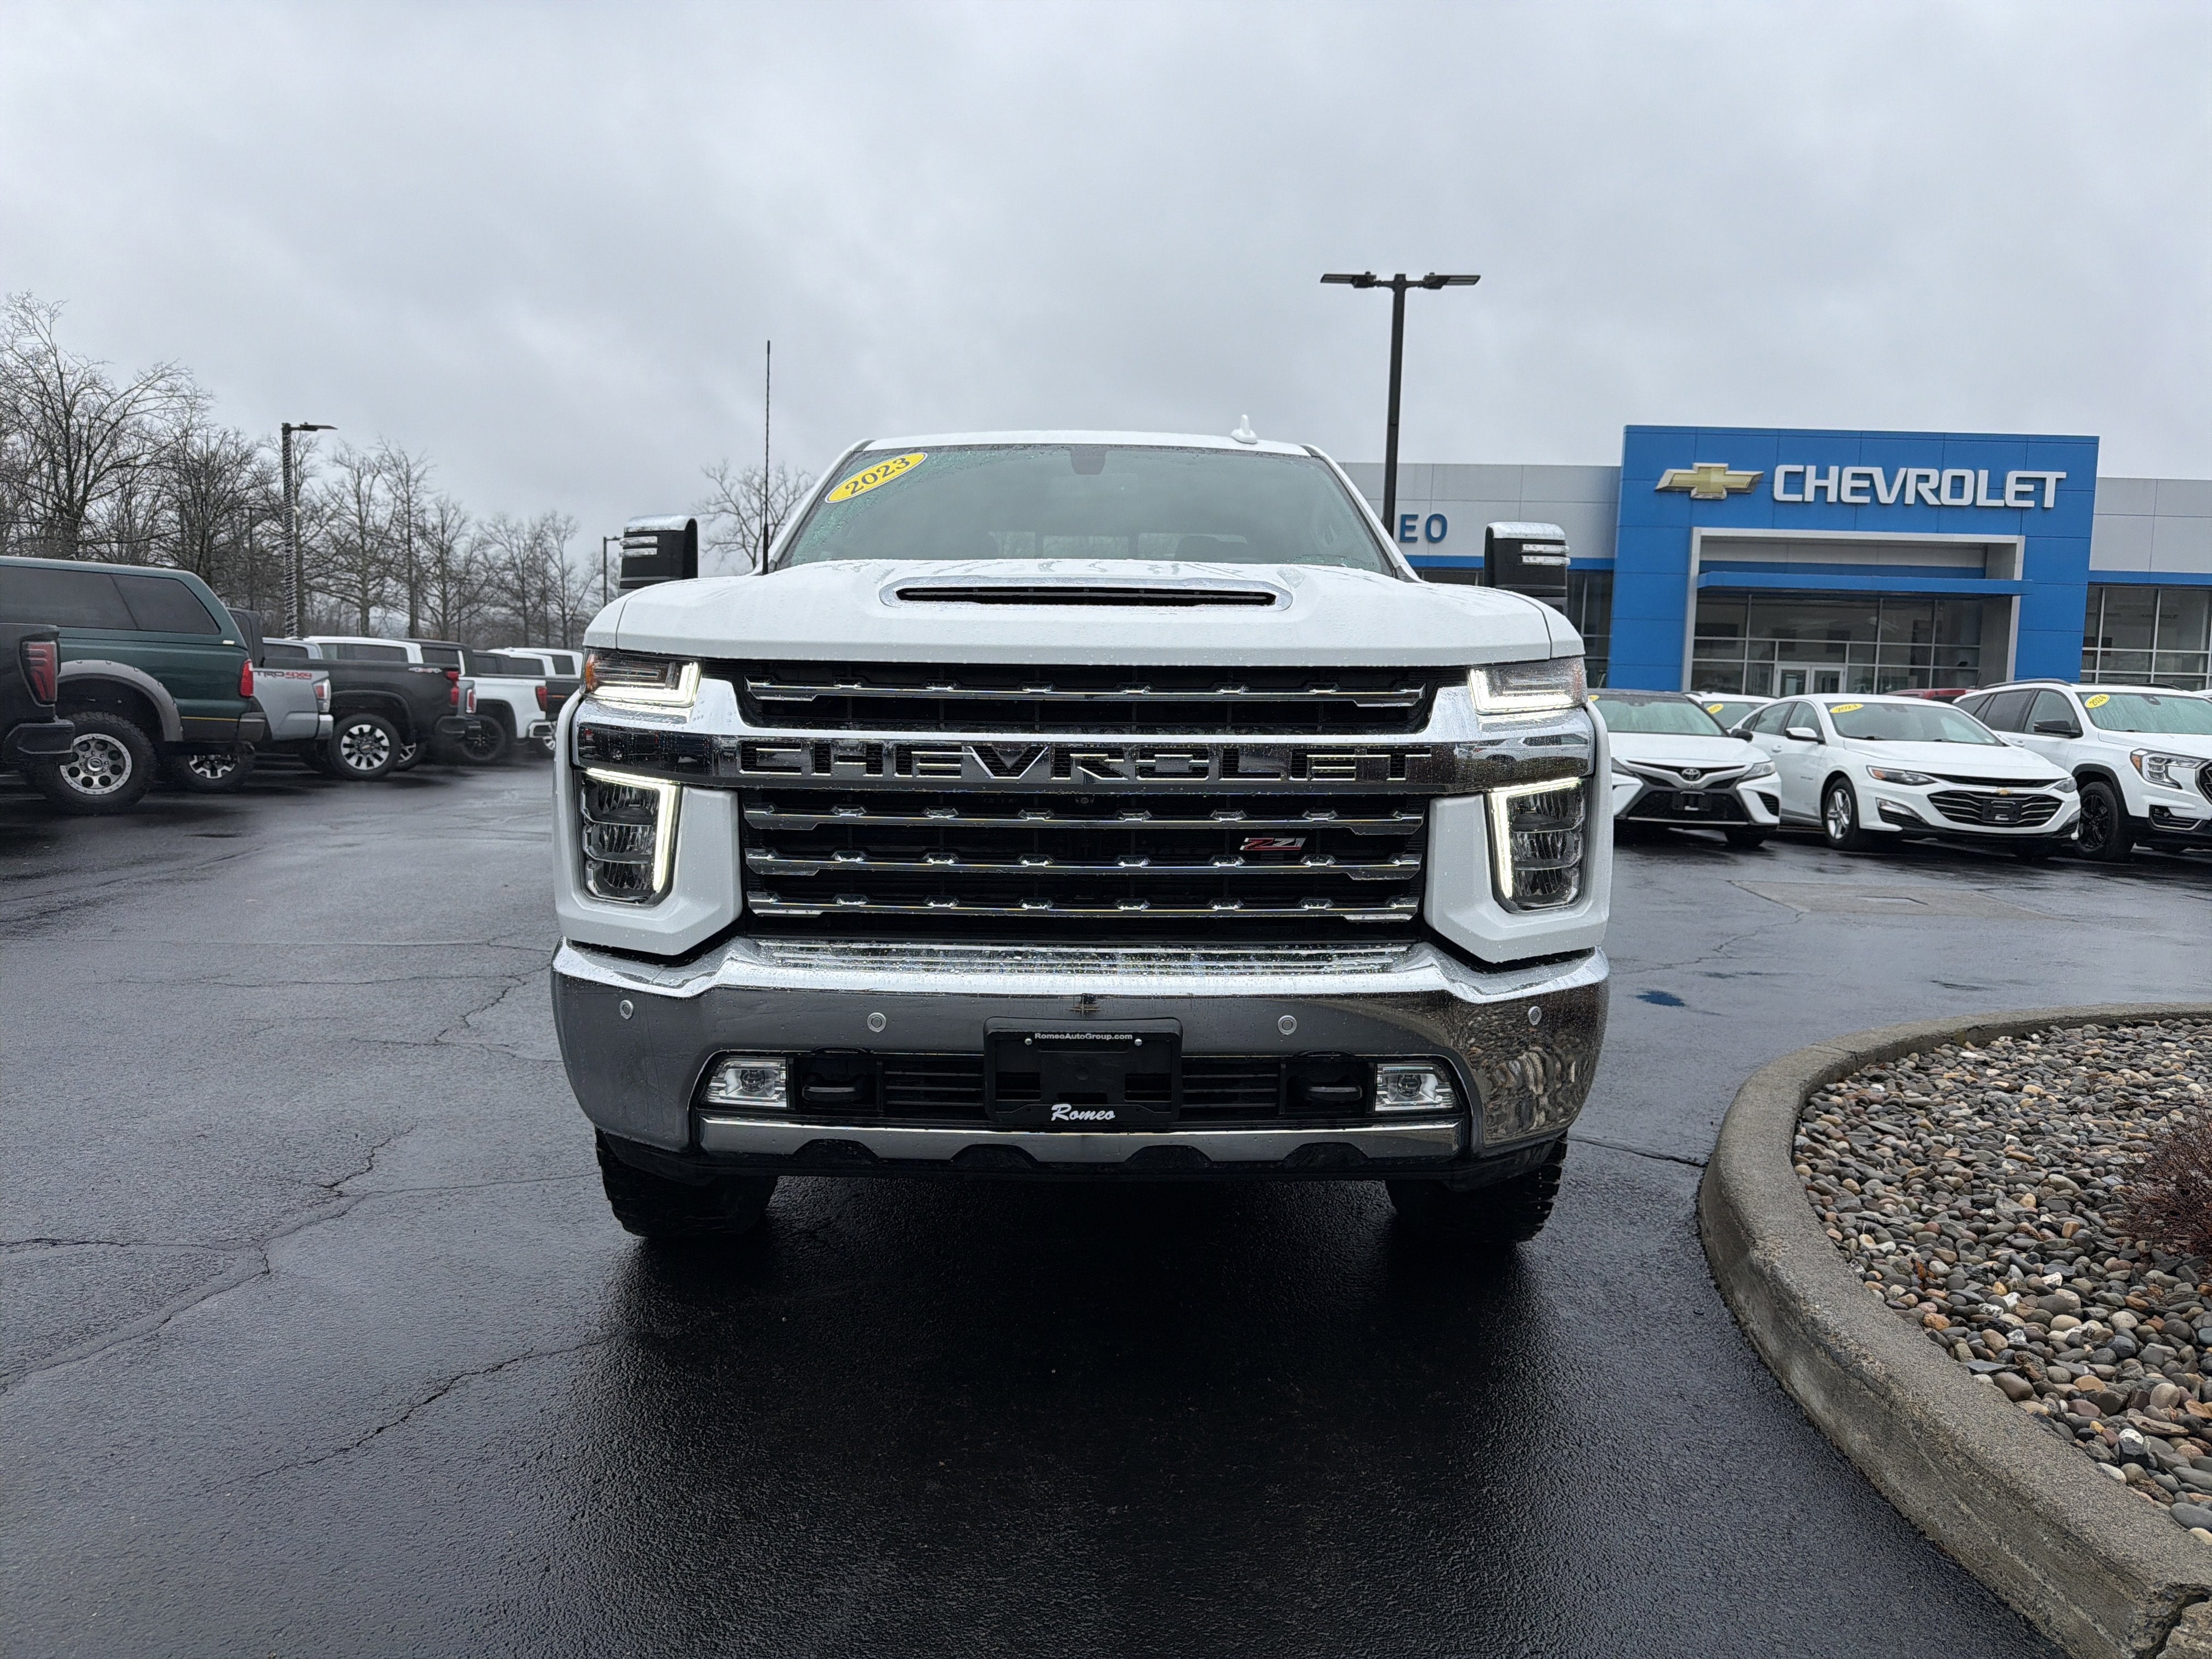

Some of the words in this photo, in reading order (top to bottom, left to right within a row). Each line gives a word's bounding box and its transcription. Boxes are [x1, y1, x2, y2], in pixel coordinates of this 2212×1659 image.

[845, 458, 911, 495] 2023
[1773, 464, 2067, 508] CHEVROLET
[2089, 695, 2106, 706] 2024
[741, 741, 1432, 781] CHEVROLET
[1239, 837, 1306, 850] Z71
[1035, 1032, 1133, 1041] RomeoAutoGroup.com
[1051, 1103, 1115, 1121] Romeo
